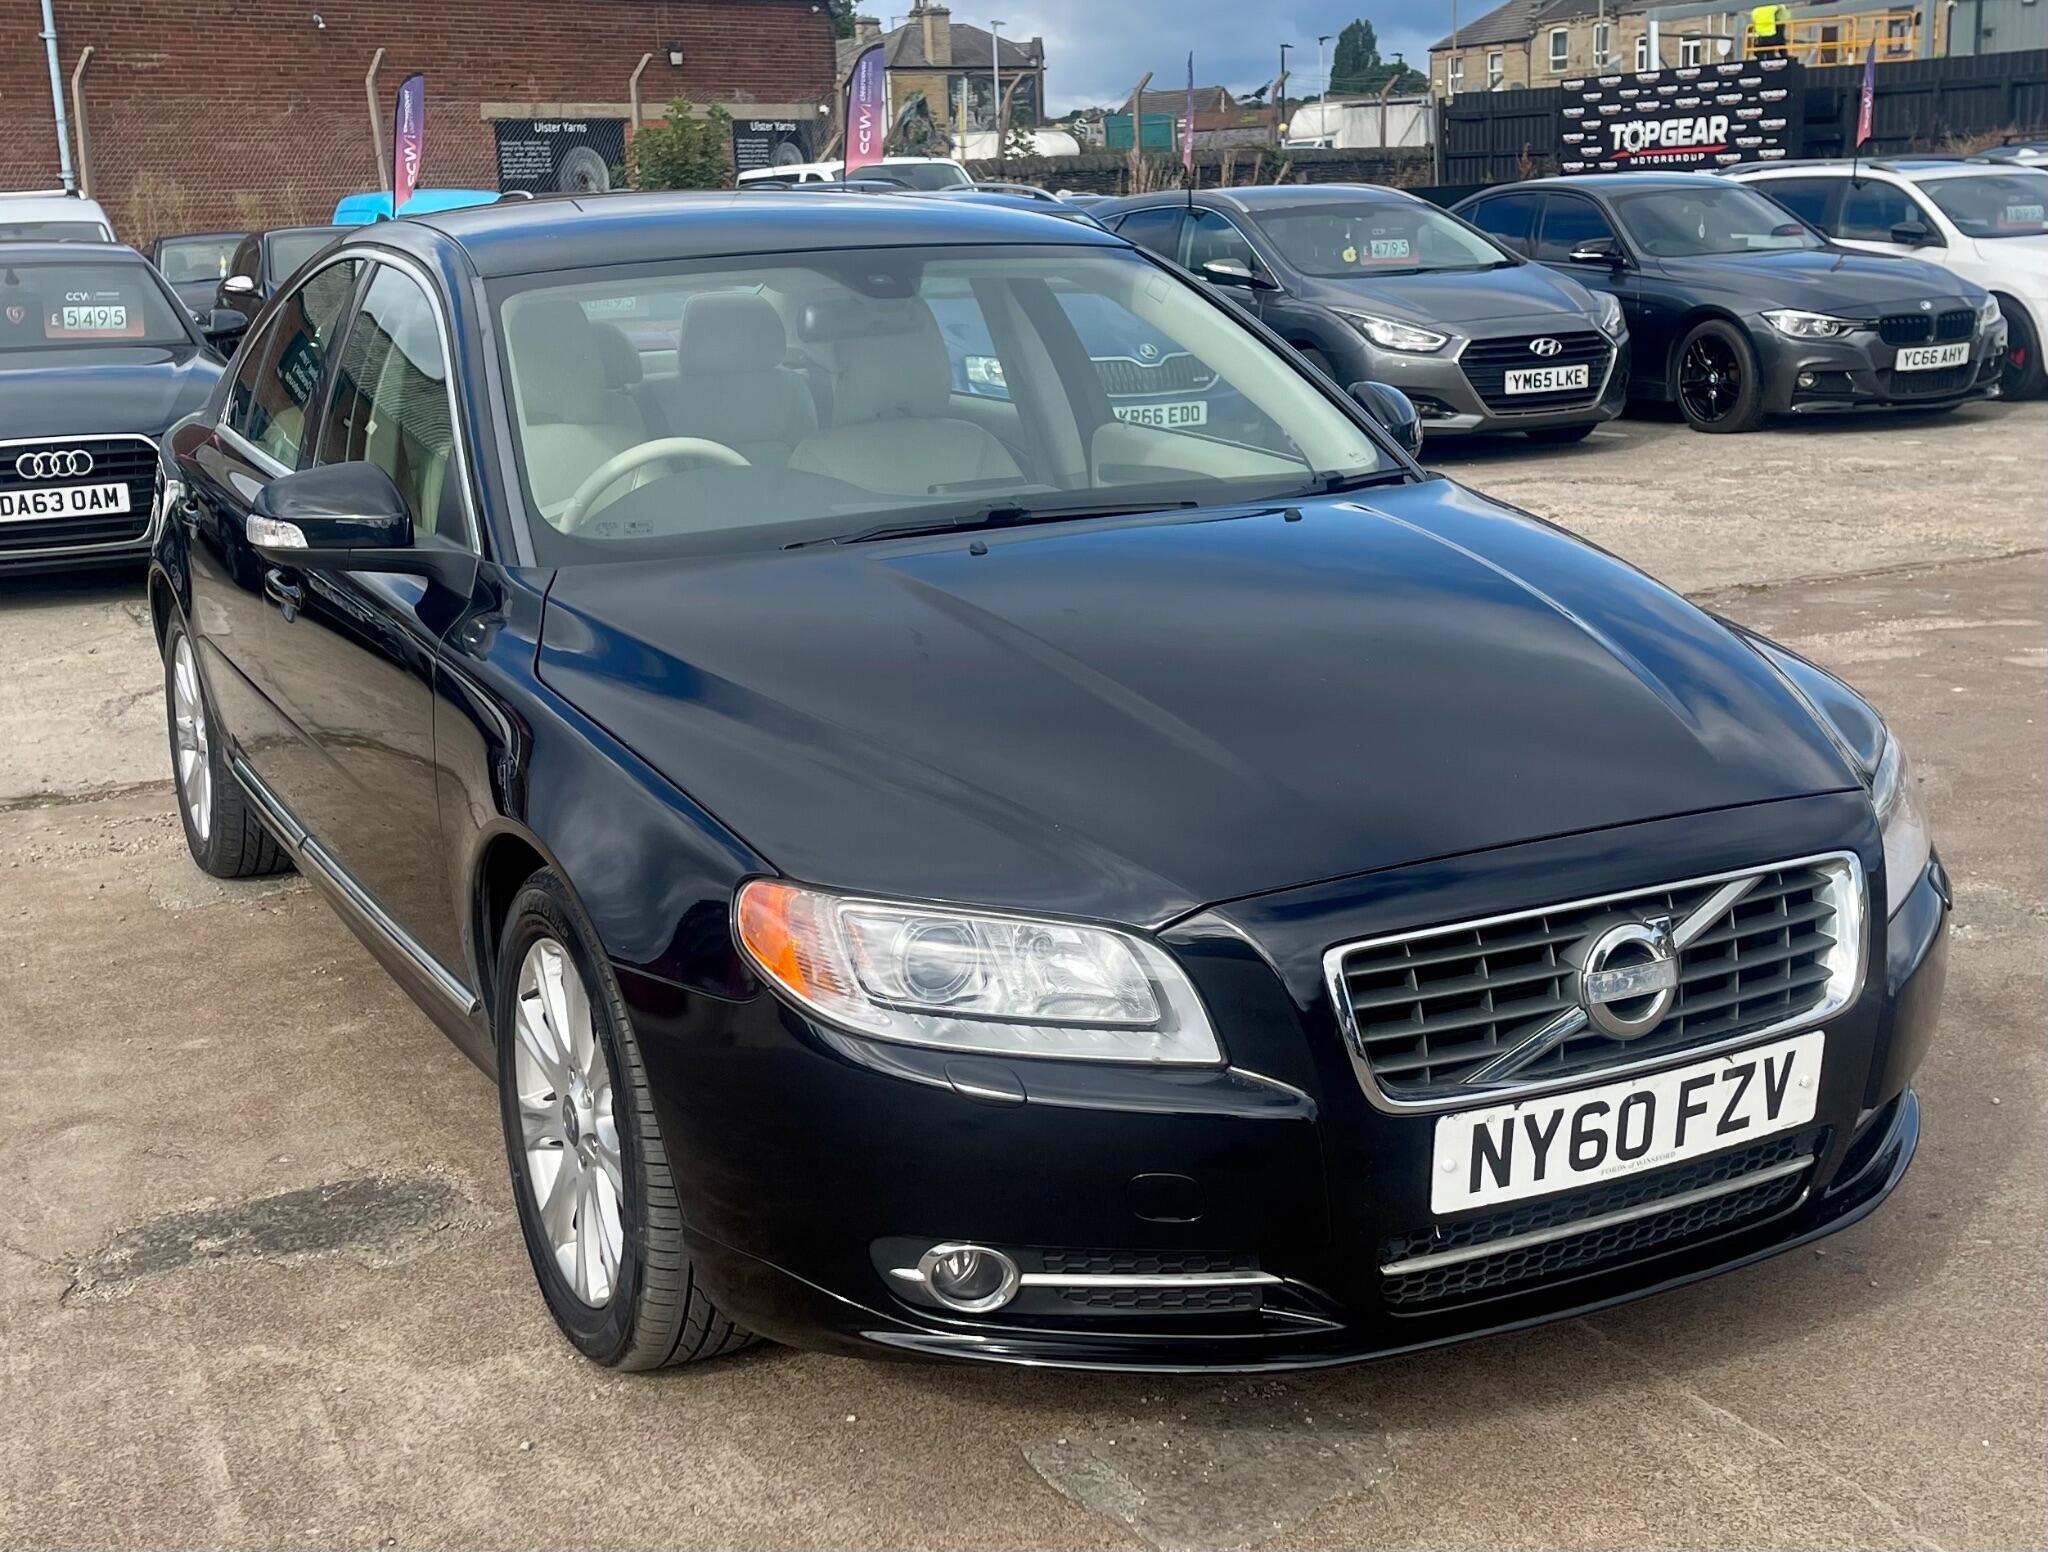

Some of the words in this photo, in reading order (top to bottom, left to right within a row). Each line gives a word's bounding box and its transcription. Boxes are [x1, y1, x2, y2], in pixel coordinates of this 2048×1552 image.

[562, 122, 588, 133] Yarns
[859, 105, 873, 155] CCW
[1609, 115, 1729, 154] TOPGEAR
[1629, 153, 1706, 165] MOTORGROUP
[1374, 241, 1409, 256] 4795
[65, 309, 126, 327] 5495
[1904, 350, 1939, 367] YC66
[1940, 346, 1965, 364] AHY
[1512, 372, 1553, 391] YM65
[1556, 368, 1583, 387] LKE
[0, 491, 65, 516] DA63
[70, 486, 119, 511] OAM
[1468, 1090, 1657, 1194] NY60
[1673, 1050, 1797, 1150] FZV
